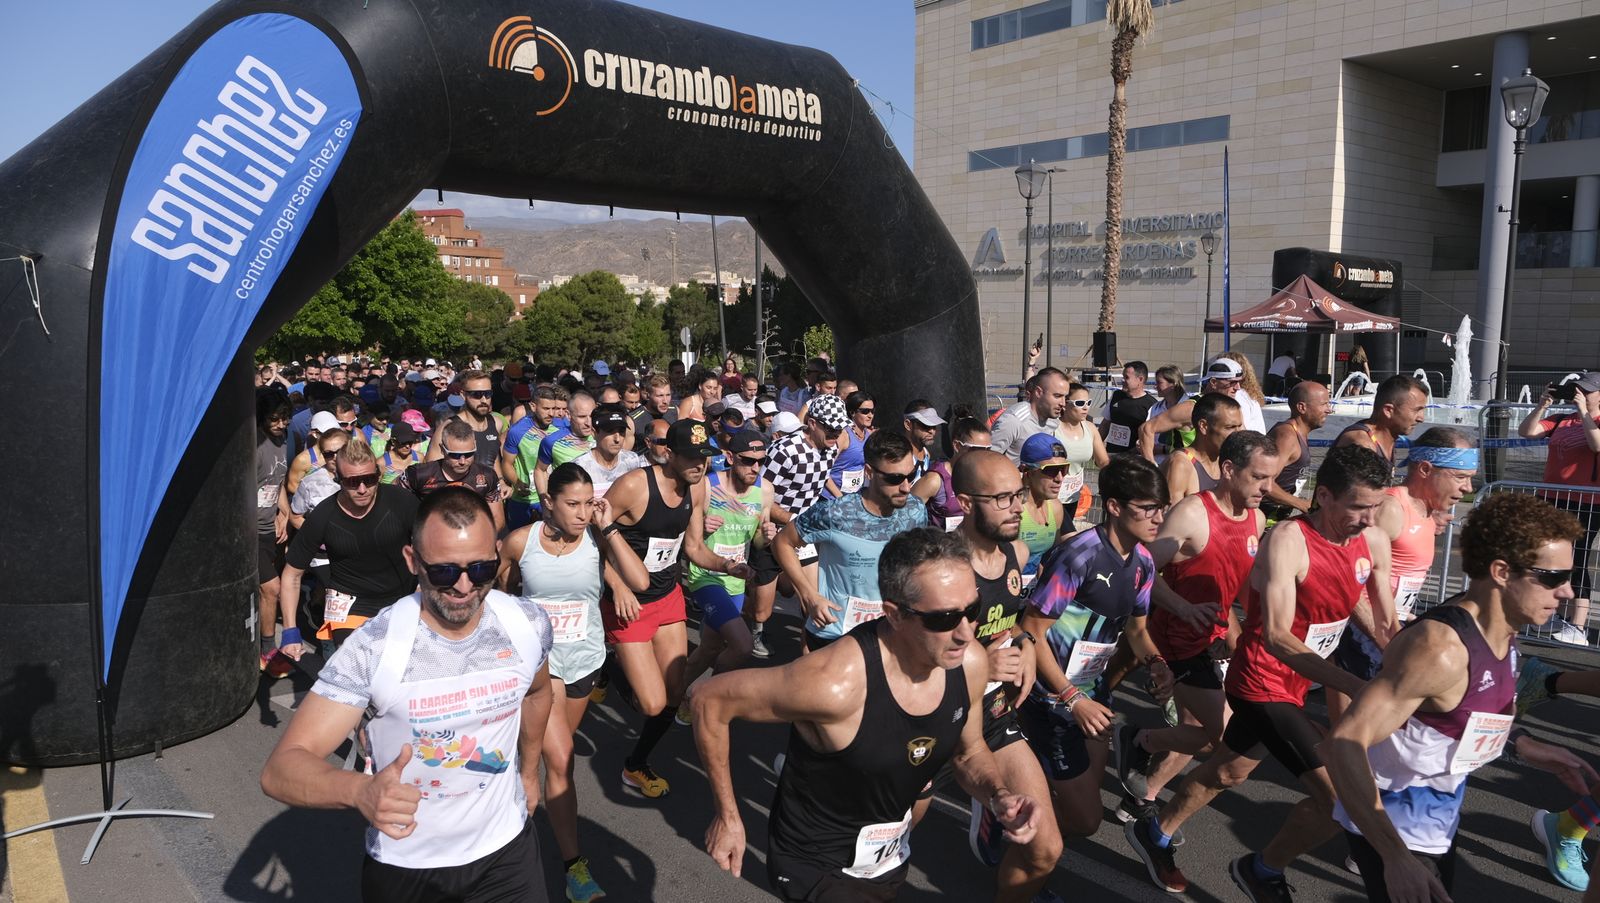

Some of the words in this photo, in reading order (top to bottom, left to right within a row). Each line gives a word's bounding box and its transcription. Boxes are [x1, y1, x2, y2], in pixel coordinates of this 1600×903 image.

[667, 106, 761, 133] cronometraje
[763, 119, 822, 142] deportivo
[235, 118, 353, 300] centrohogarsanchez.es
[1119, 211, 1224, 235] IVERSITARIO
[1050, 240, 1197, 263] TORRERDENAS
[1040, 269, 1085, 281] HSPITAL
[987, 603, 1003, 623] GO
[469, 686, 489, 699] SIN
[874, 838, 902, 864] 10
